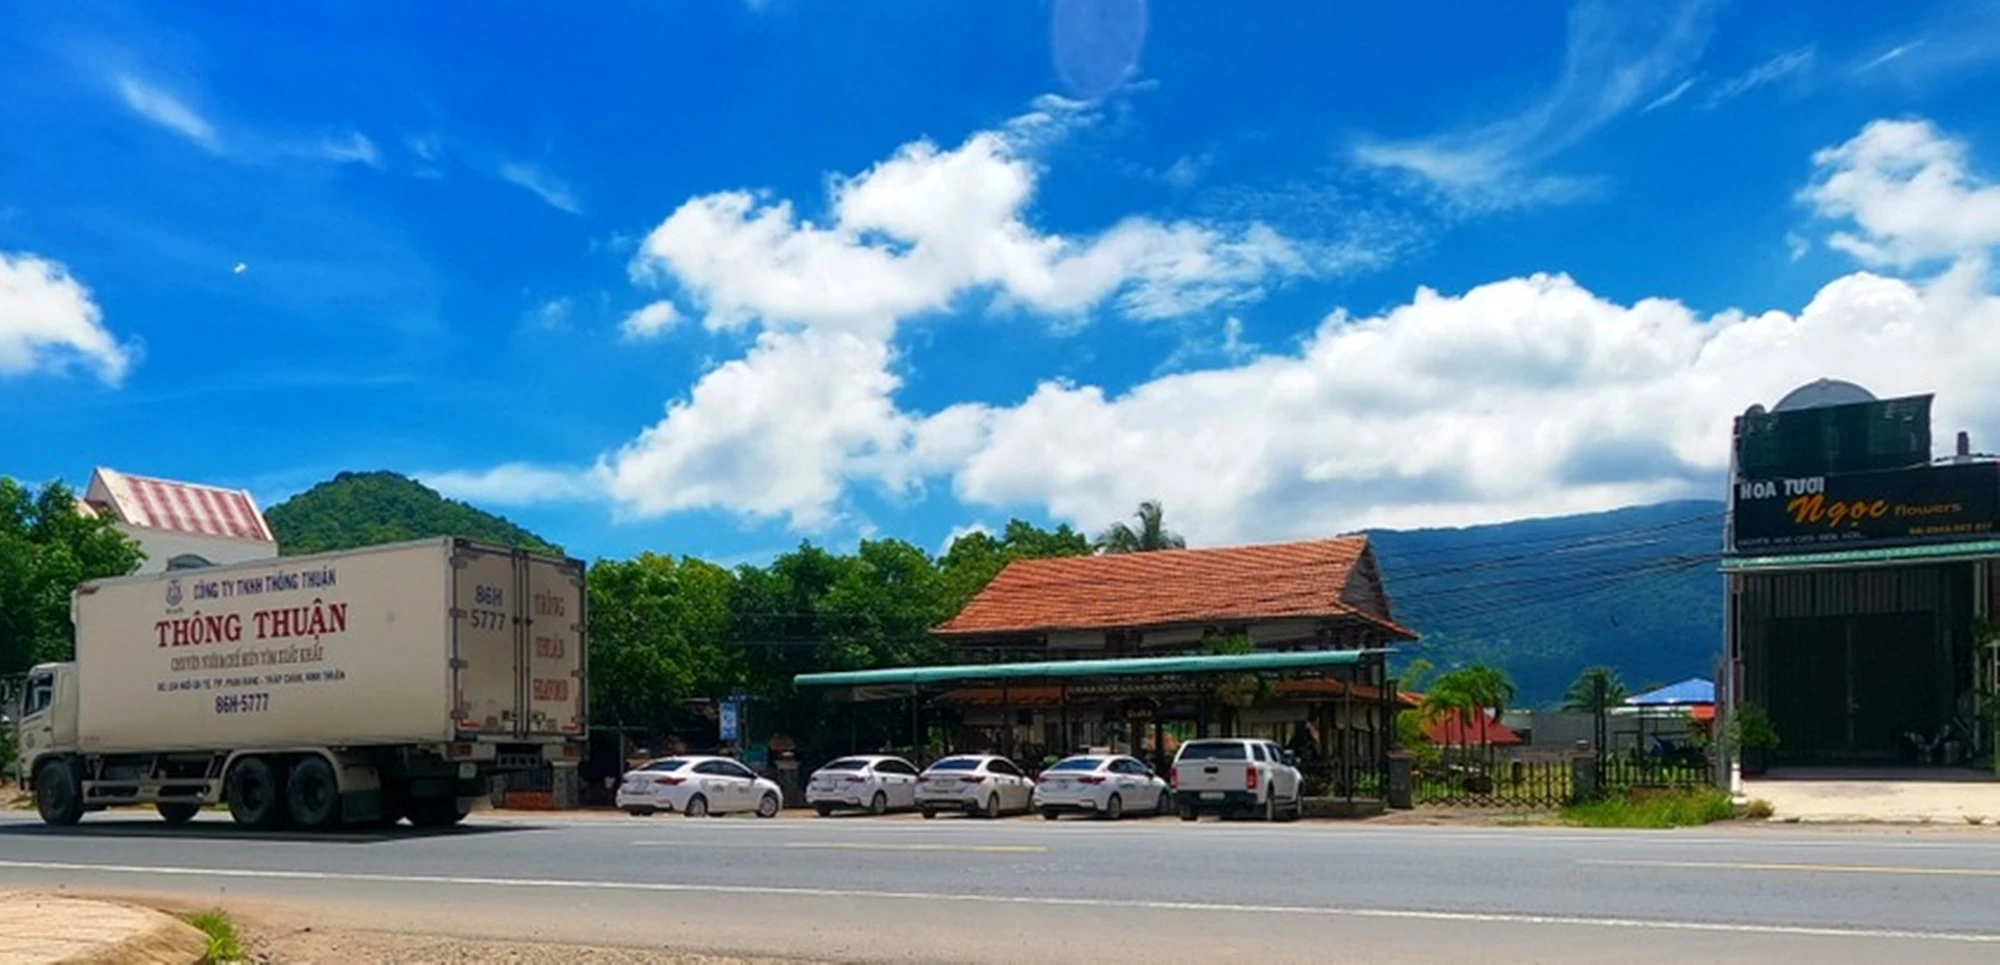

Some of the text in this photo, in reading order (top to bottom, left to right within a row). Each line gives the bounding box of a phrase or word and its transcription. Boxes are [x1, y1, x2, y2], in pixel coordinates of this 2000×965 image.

[1740, 481, 1777, 500] HOA
[1787, 493, 1889, 528] Ngọc
[1894, 501, 1962, 518] flowers
[193, 566, 336, 600] CÔNG TY TNHH THÔNG THUẬN
[475, 585, 503, 606] 86H
[155, 598, 349, 648] THÔNG THUẬN
[471, 609, 506, 631] 5777
[215, 693, 269, 714] 86H-5777
